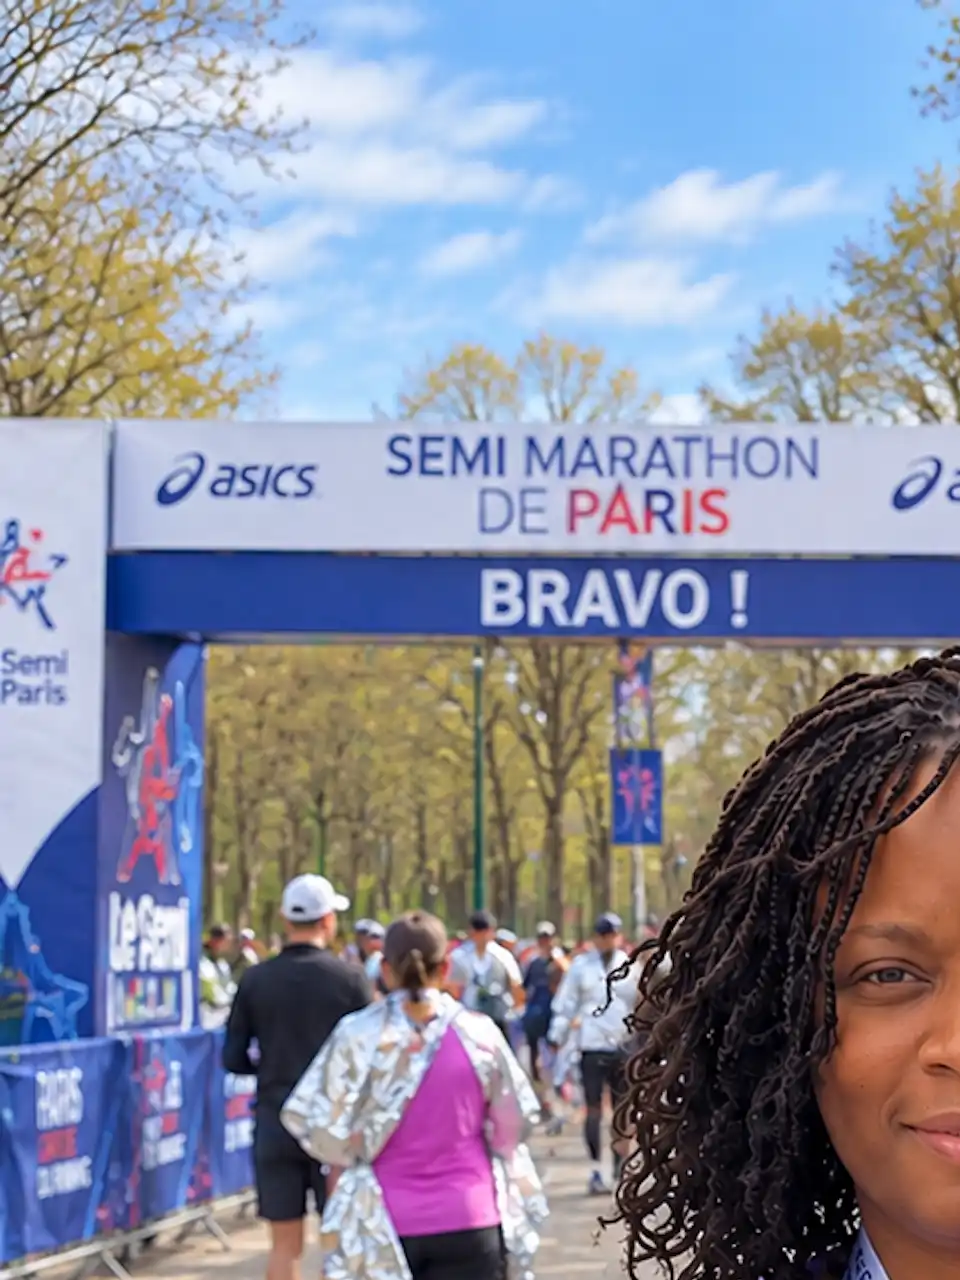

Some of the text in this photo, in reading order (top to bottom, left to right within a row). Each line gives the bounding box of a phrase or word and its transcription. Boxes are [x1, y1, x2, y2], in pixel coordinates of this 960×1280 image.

[386, 434, 820, 479] SEMI MARATHON
[478, 483, 730, 535] DE PARIS
[480, 568, 710, 629] BRAVO
[0, 648, 69, 677] Semi
[0, 679, 68, 706] Paris
